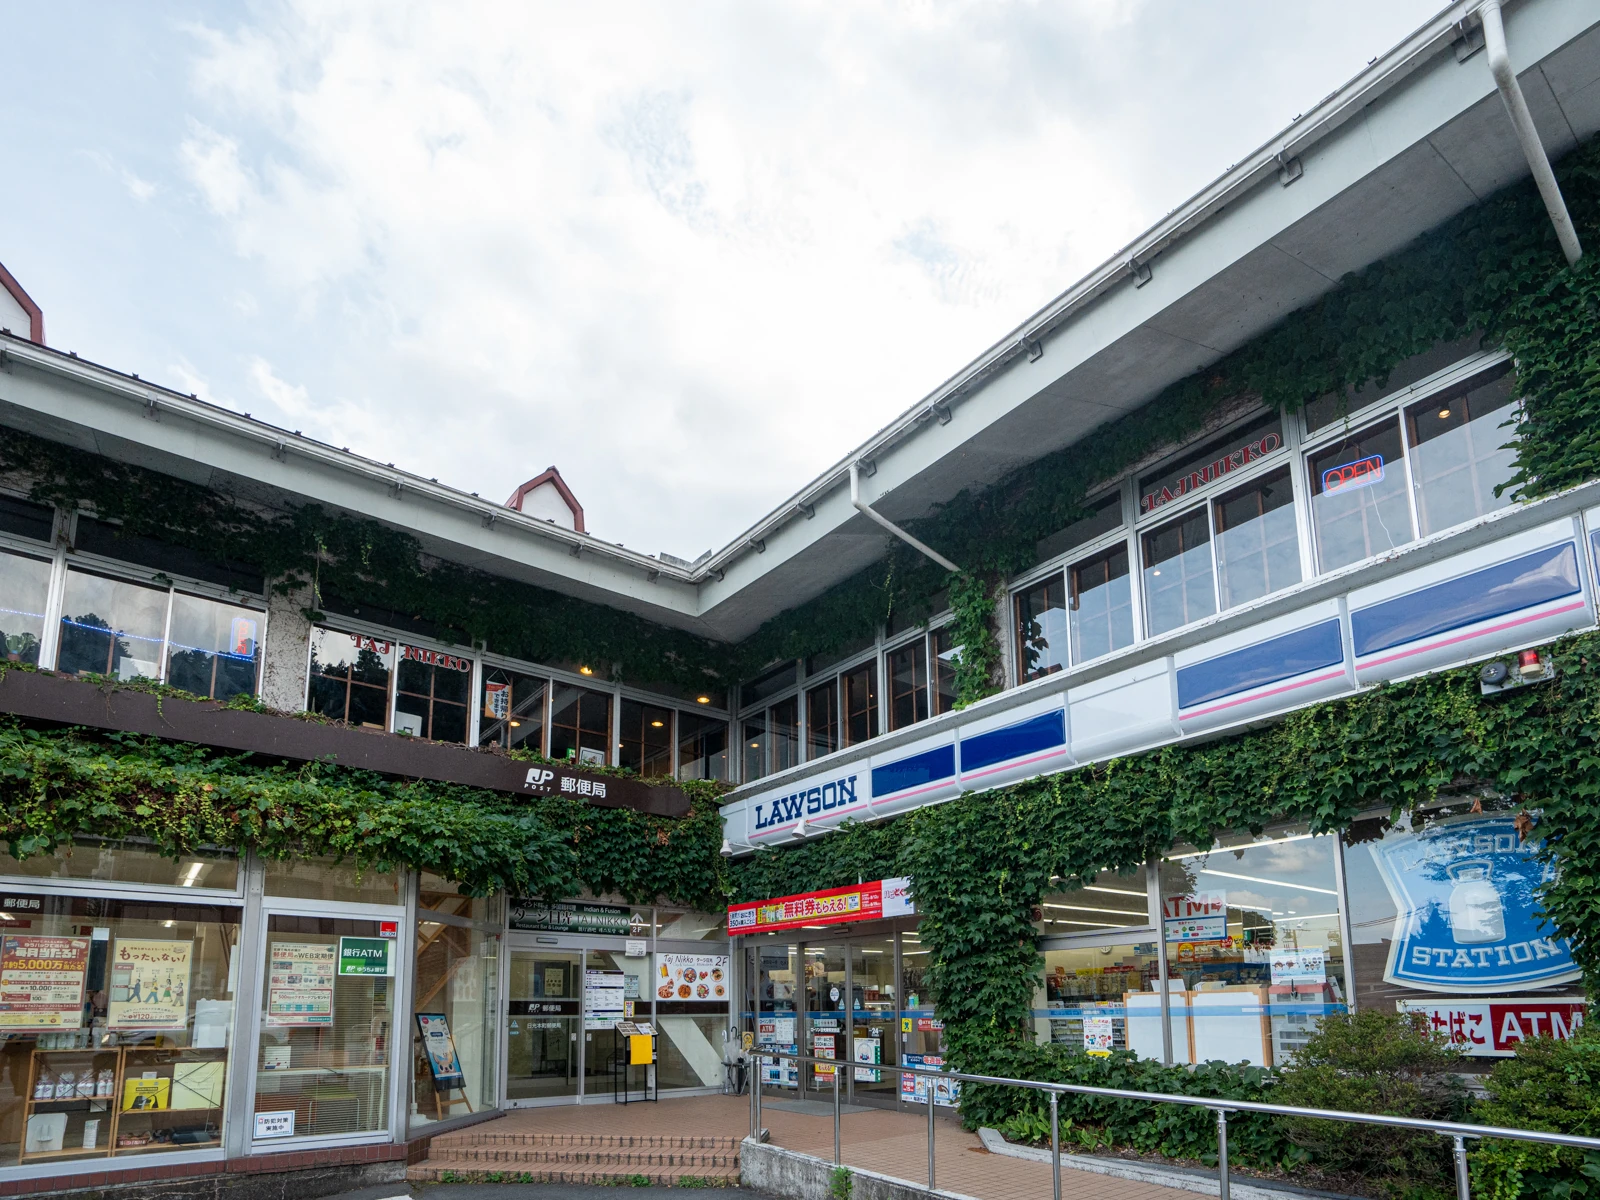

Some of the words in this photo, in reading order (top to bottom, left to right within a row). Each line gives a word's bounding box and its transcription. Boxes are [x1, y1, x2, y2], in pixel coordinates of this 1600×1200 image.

[1140, 477, 1188, 512] TAJ
[1189, 432, 1281, 490] NIKKO
[1326, 457, 1381, 492] OPEN
[350, 633, 391, 655] TAJ
[403, 645, 471, 673] NIKKO
[523, 783, 552, 792] POST
[561, 776, 607, 799] 郵便局
[755, 774, 858, 830] LAWSON
[3, 897, 41, 909] 郵便局
[783, 896, 847, 919] 無料券もらえる!
[513, 906, 574, 926] タージ日光
[577, 915, 593, 924] TAJ
[596, 916, 629, 927] NIKKO
[71, 925, 78, 935] 1
[15, 947, 77, 959] 毎月当たる!
[119, 946, 186, 963] もったいない!
[343, 948, 382, 958] 銀行ATM
[664, 954, 674, 965] Taj
[675, 955, 694, 963] Nikko
[1411, 935, 1563, 970] STATION
[715, 956, 729, 967] 2F
[542, 1004, 562, 1012] 郵便局
[1499, 1010, 1584, 1044] ATM
